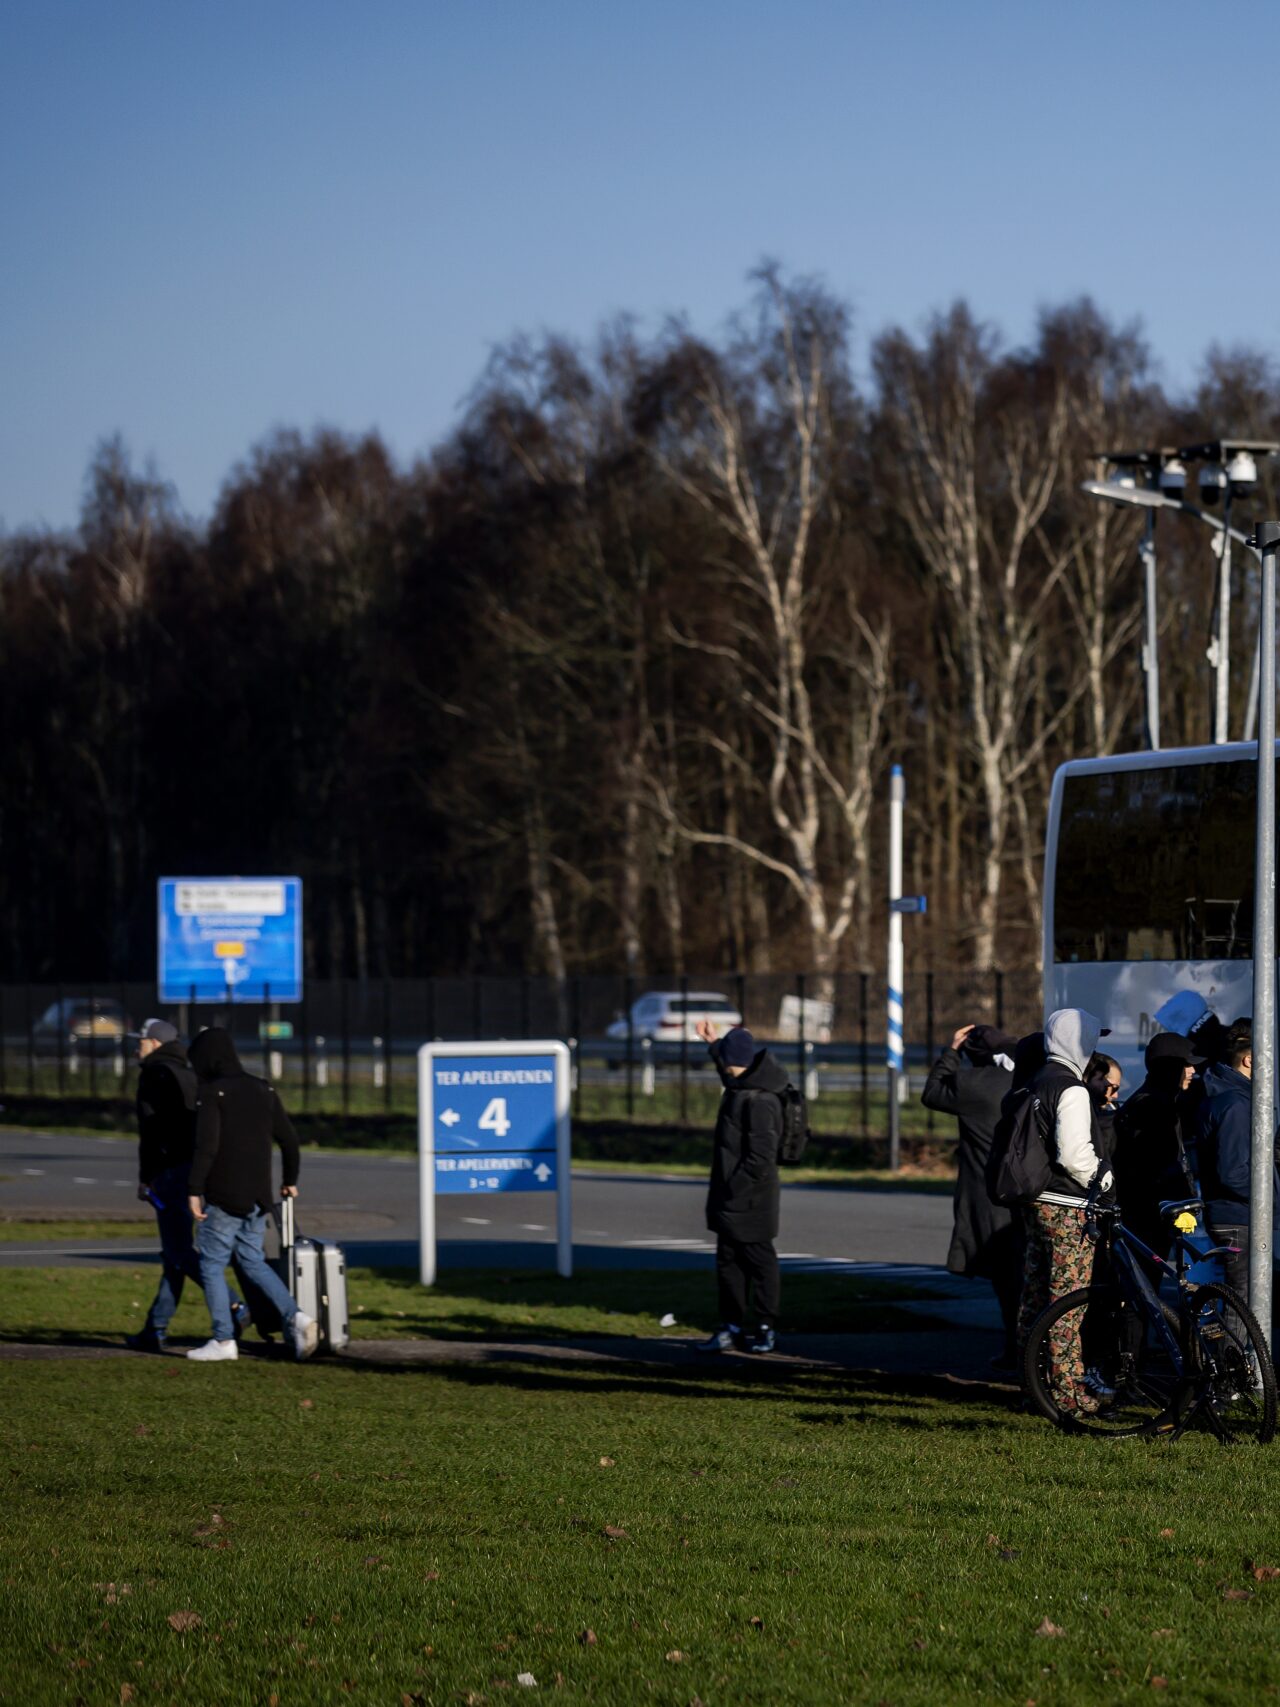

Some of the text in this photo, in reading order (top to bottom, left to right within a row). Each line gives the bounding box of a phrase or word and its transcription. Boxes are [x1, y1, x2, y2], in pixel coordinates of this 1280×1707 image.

[434, 1069, 553, 1085] TER APELERVENEN
[478, 1097, 511, 1137] 4
[435, 1158, 457, 1171] TER
